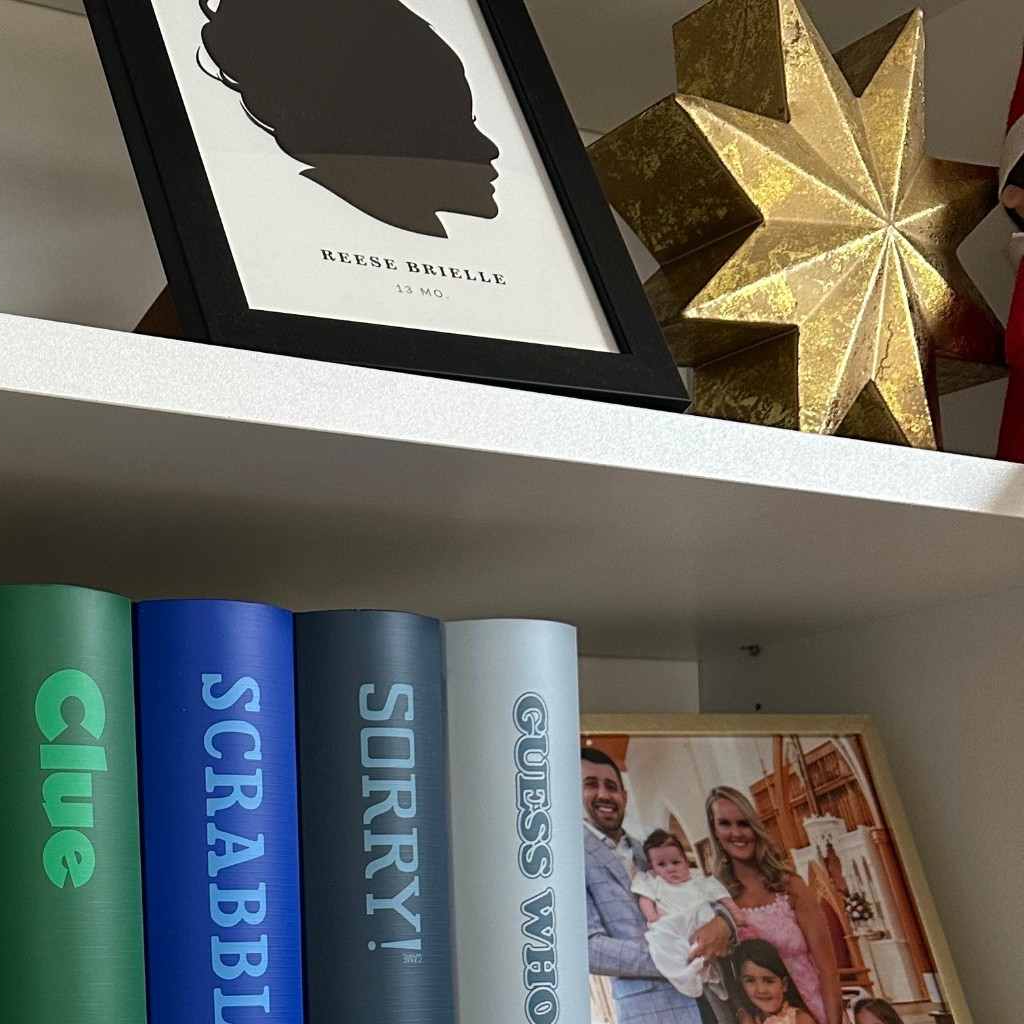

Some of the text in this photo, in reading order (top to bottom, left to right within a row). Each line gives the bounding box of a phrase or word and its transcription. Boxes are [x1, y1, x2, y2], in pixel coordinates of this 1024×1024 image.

[320, 248, 507, 285] REESE BRIELLE
[395, 283, 450, 299] 13 MO.
[34, 668, 108, 889] Clue
[358, 683, 422, 951] SORRY!
[512, 691, 554, 880] GUESS
